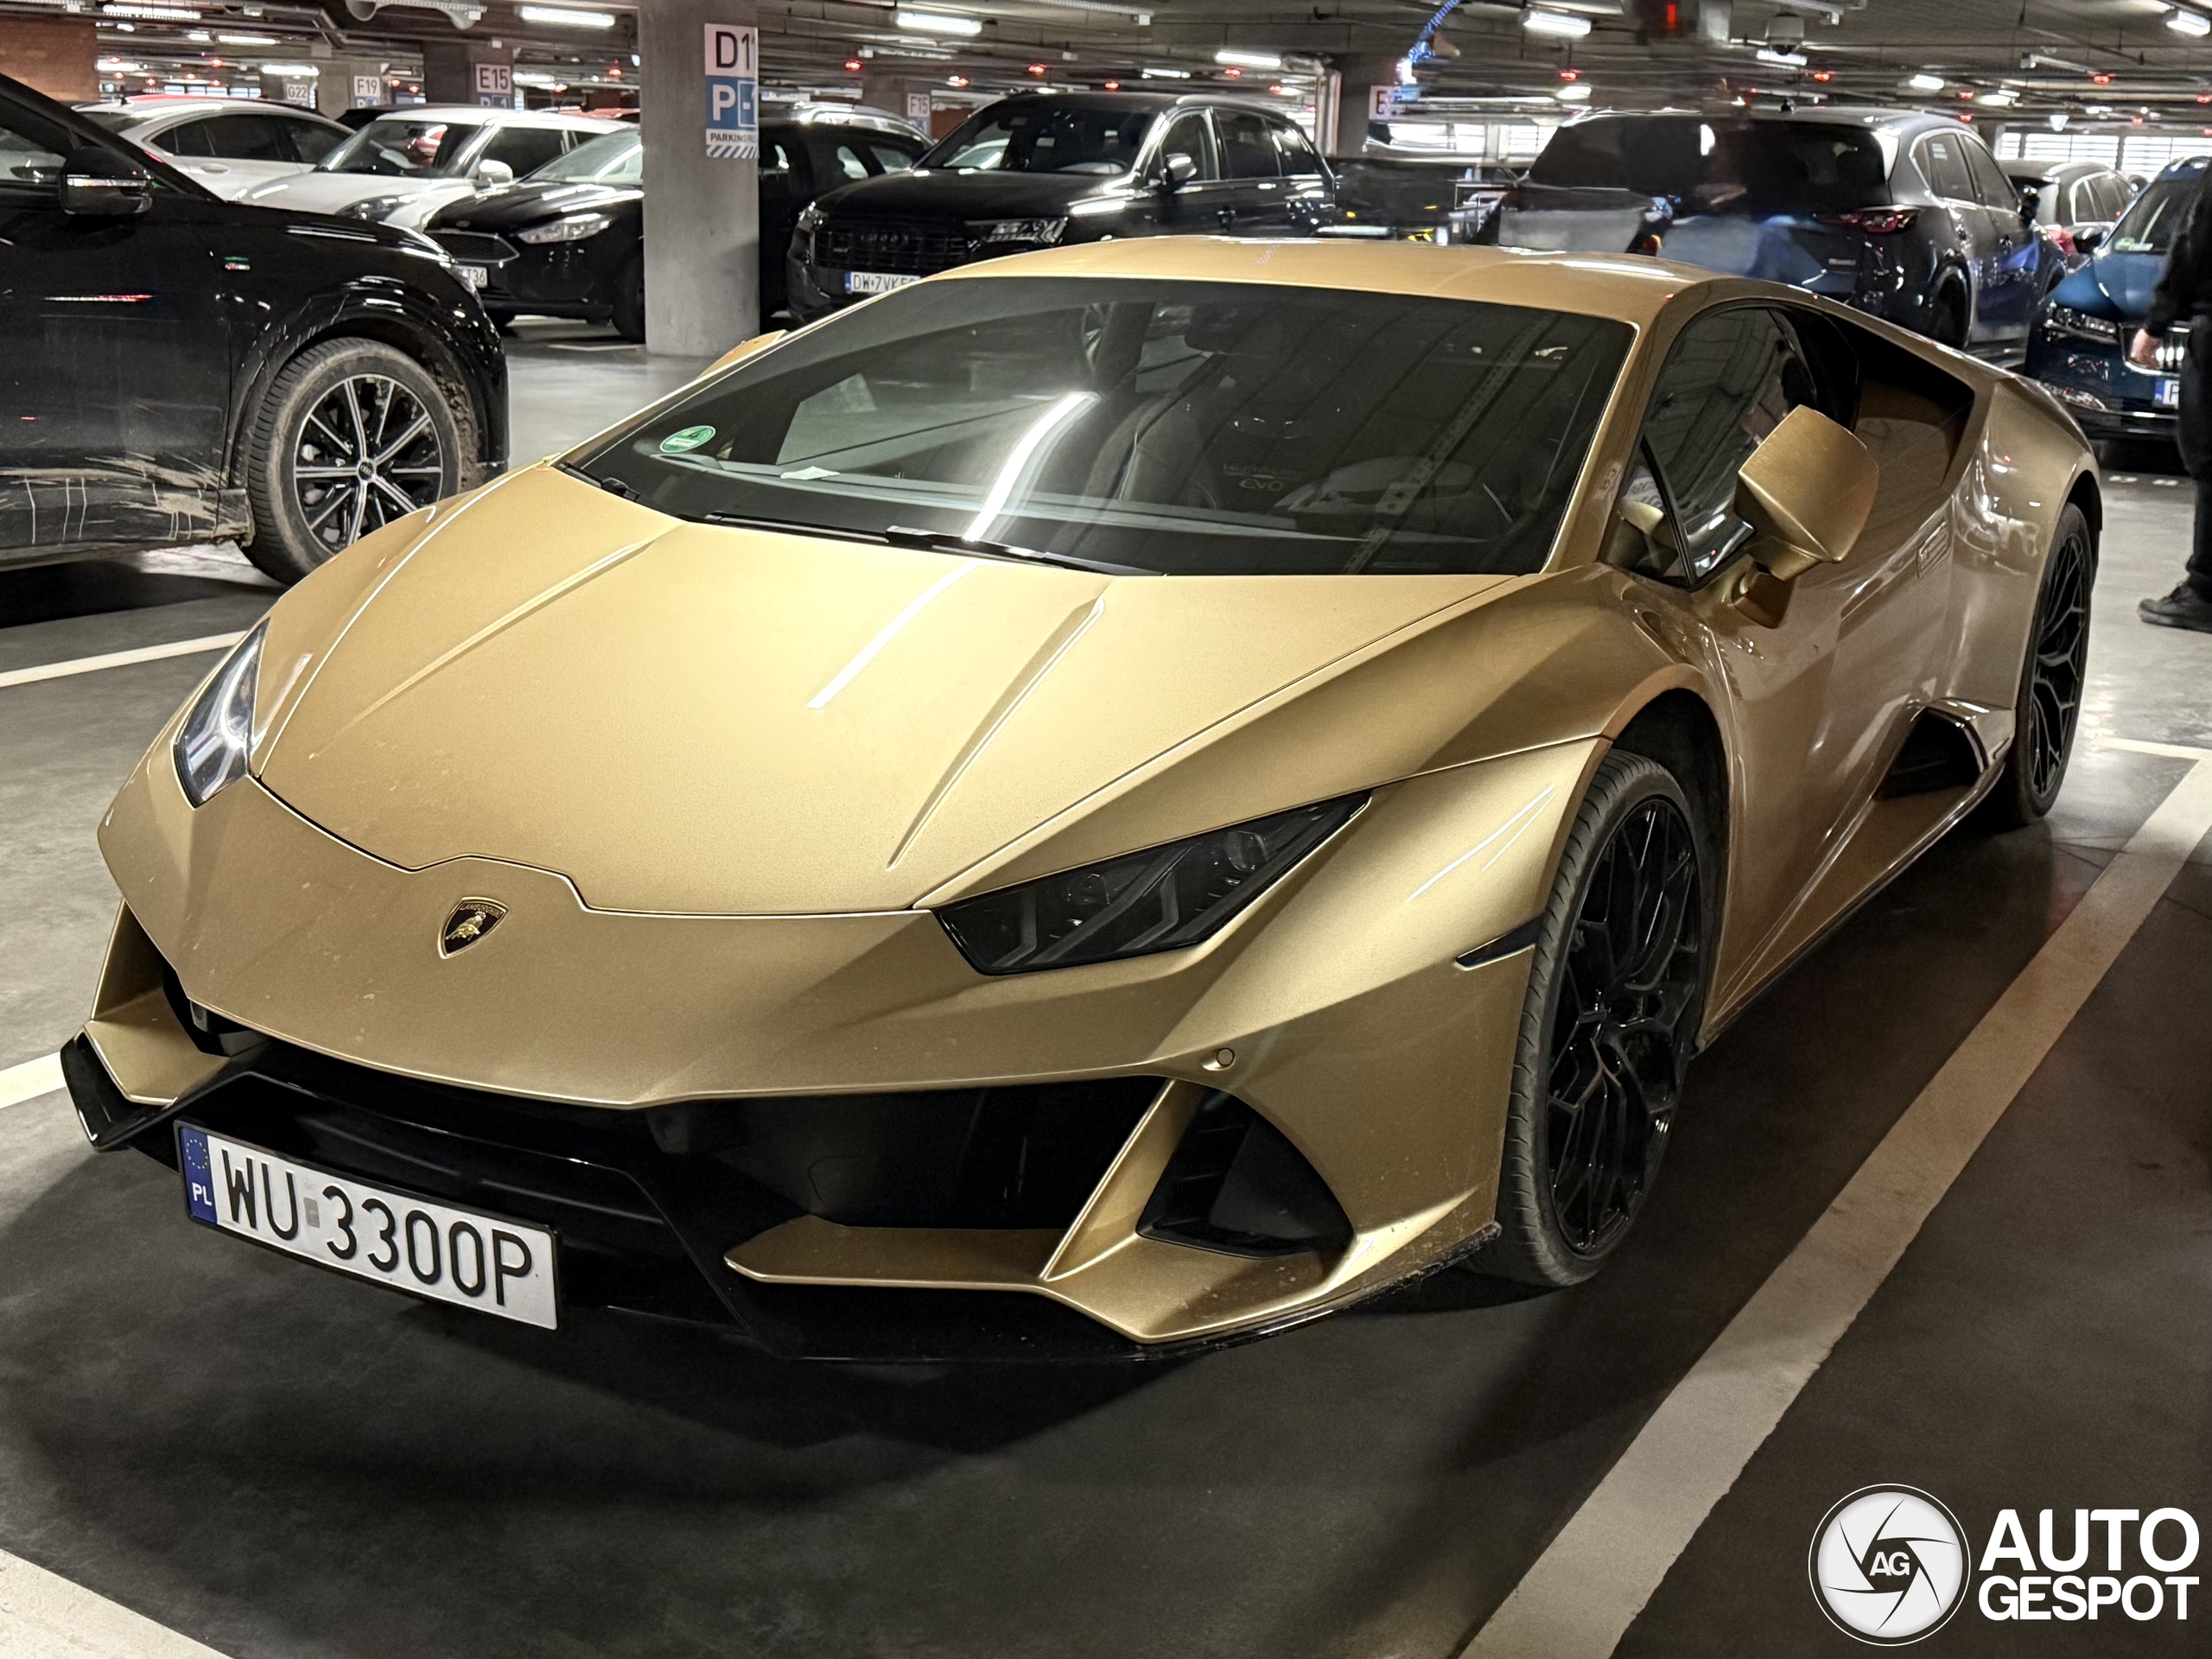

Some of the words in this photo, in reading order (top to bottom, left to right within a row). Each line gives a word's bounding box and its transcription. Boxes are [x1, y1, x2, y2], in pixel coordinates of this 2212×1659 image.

[715, 31, 754, 71] D1
[358, 79, 378, 94] F19
[480, 67, 508, 90] E15
[288, 86, 307, 99] G22
[712, 84, 735, 121] P
[910, 96, 929, 114] F15
[192, 1182, 213, 1206] PL
[221, 1148, 299, 1241] WU
[321, 1185, 532, 1306] 3300P
